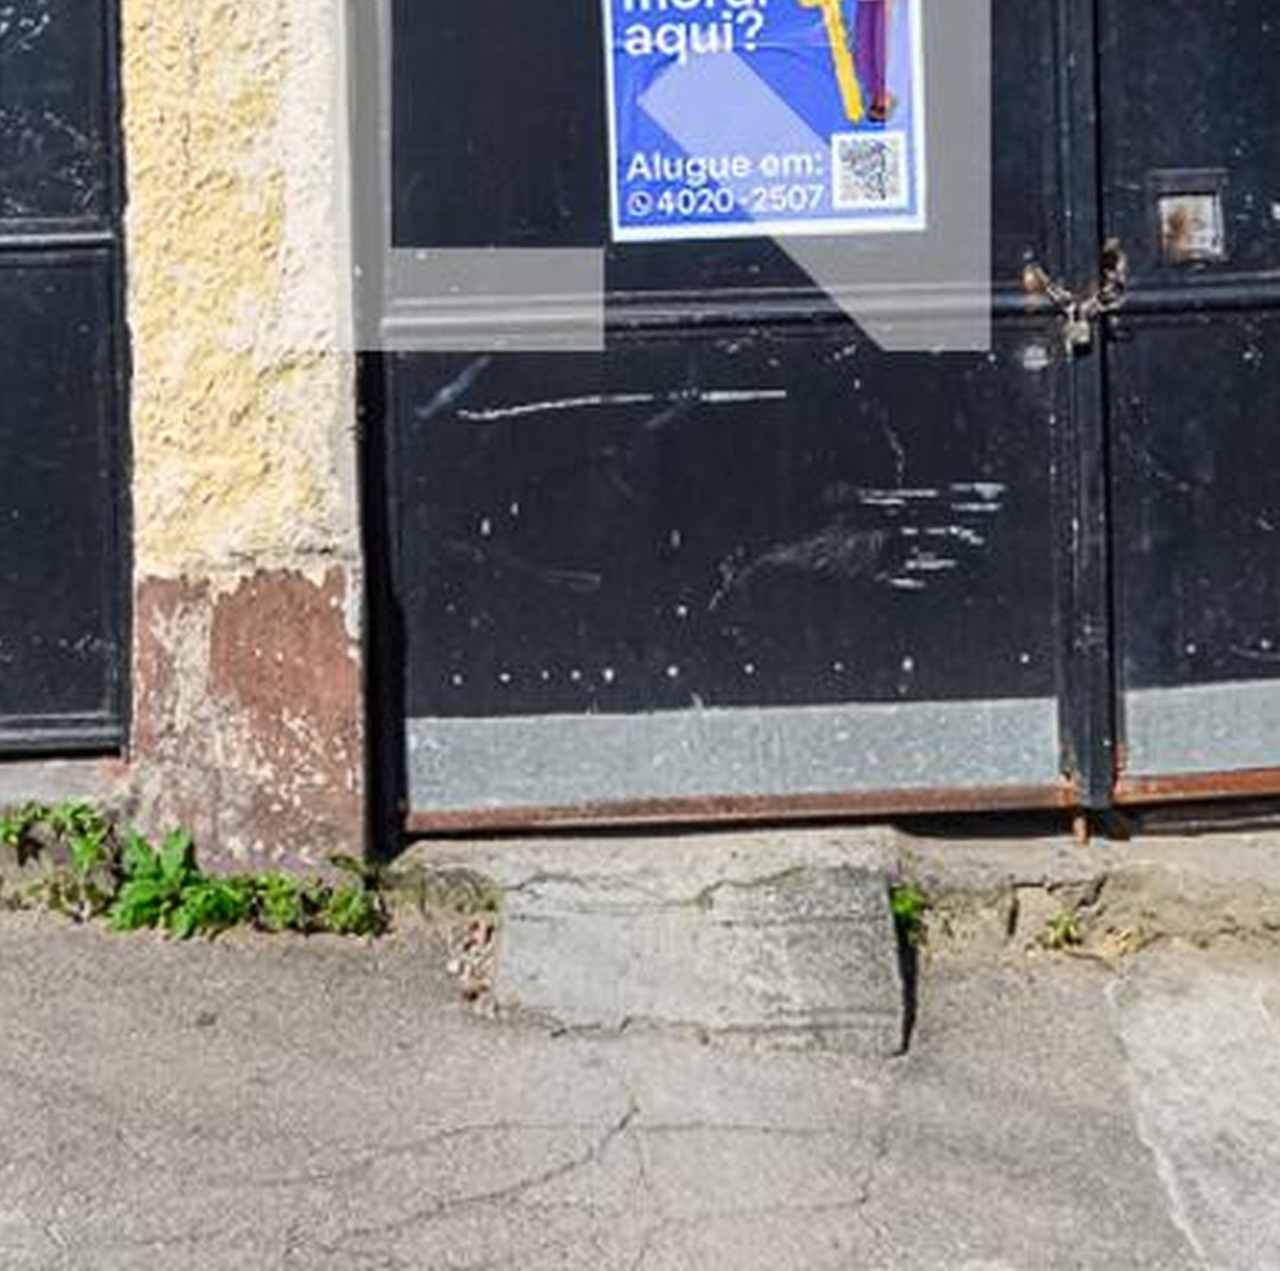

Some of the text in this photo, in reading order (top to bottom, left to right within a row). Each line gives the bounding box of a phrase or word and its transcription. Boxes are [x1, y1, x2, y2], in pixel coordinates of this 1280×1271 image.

[625, 10, 765, 65] aqui?
[626, 151, 825, 187] Alugue em:
[657, 184, 825, 215] 4020-2507
